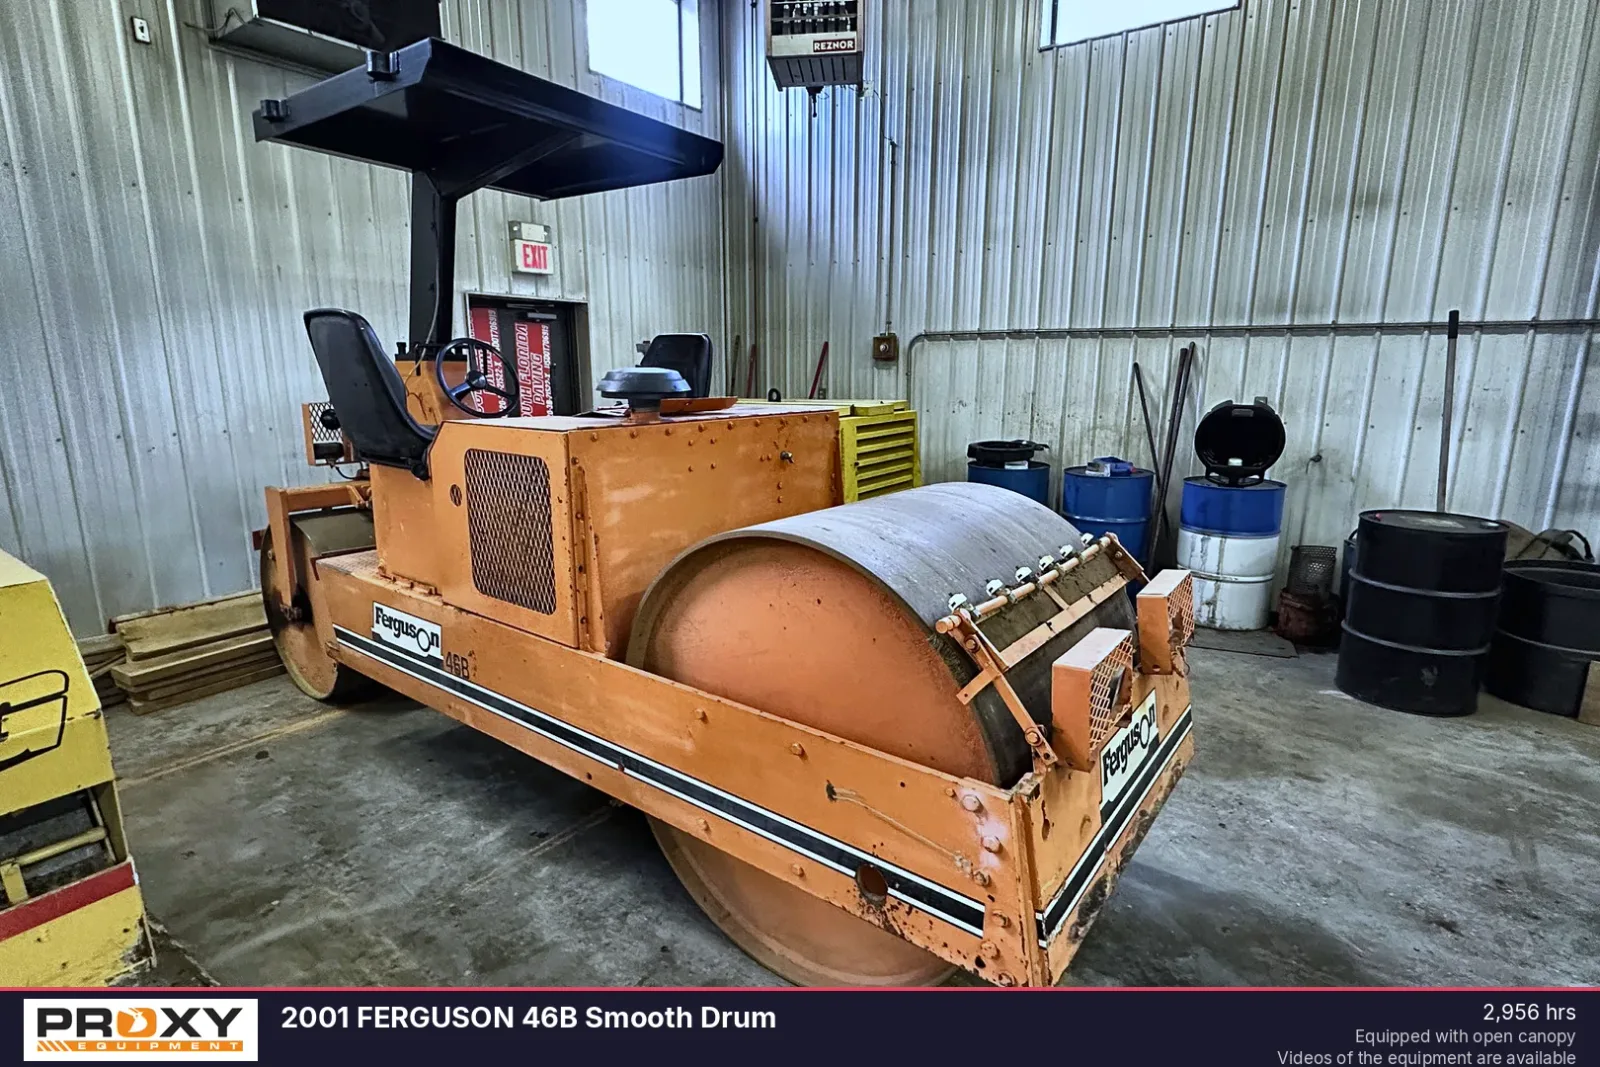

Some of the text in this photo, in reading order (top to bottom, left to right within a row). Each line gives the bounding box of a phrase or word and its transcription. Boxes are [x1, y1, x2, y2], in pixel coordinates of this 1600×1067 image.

[814, 40, 854, 51] REZNOR
[522, 243, 548, 270] EXIT
[514, 322, 533, 418] OUTH FLORIDA
[530, 352, 545, 405] PAVING
[375, 606, 440, 652] Ferguson
[445, 651, 470, 680] 46B
[1102, 703, 1156, 787] Ferguson
